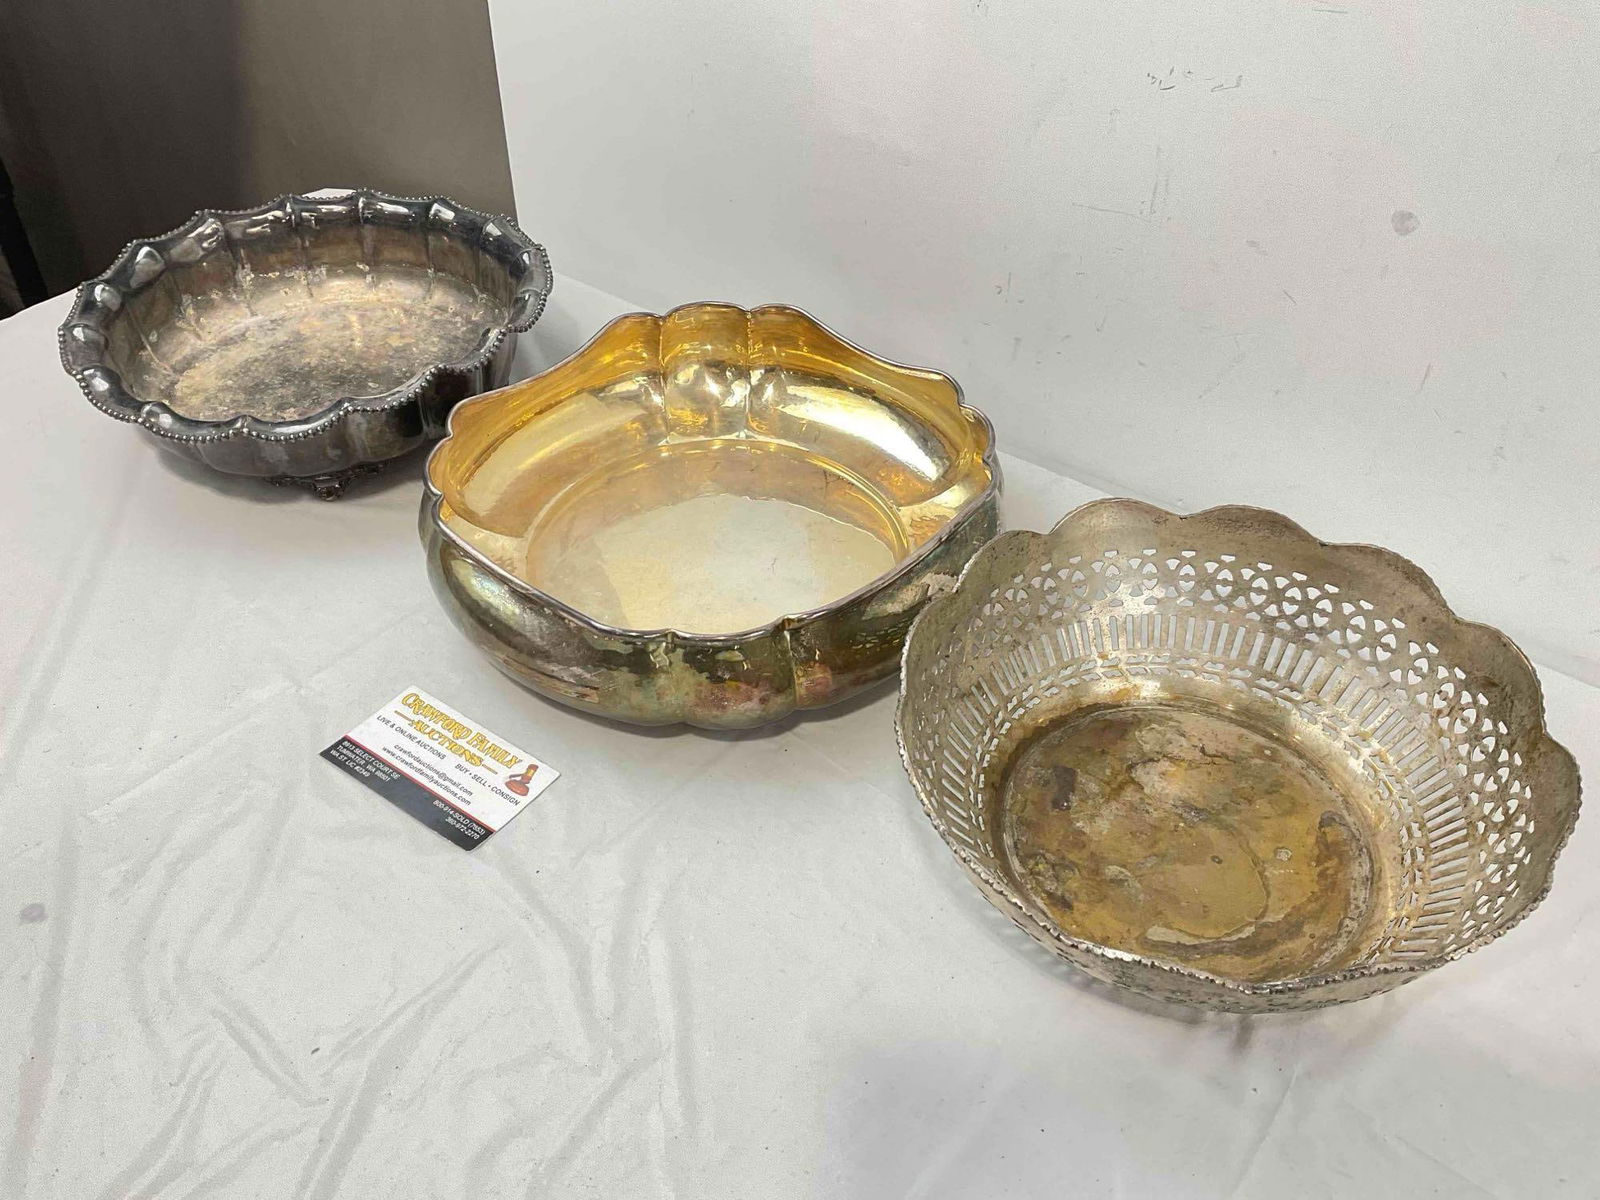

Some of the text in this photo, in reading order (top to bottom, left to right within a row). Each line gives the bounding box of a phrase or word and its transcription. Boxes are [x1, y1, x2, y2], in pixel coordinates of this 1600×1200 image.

[376, 714, 391, 725] LIVE
[394, 726, 417, 742] ONLINE
[415, 739, 447, 760] AUCTIONS
[400, 691, 523, 769] CRAWFORD FAMILY
[408, 718, 485, 768] AUCTIONS
[338, 754, 348, 762] ST
[345, 759, 357, 768] LIC
[353, 748, 374, 762] SELECT
[372, 759, 392, 774] COURT
[389, 771, 401, 780] SE
[365, 764, 376, 772] WA
[381, 746, 473, 806] www.crawfordfamilyauctions.com
[393, 743, 474, 796] crawfordauctions@gmail.com
[454, 763, 520, 806] BUY SELL CONSIGN
